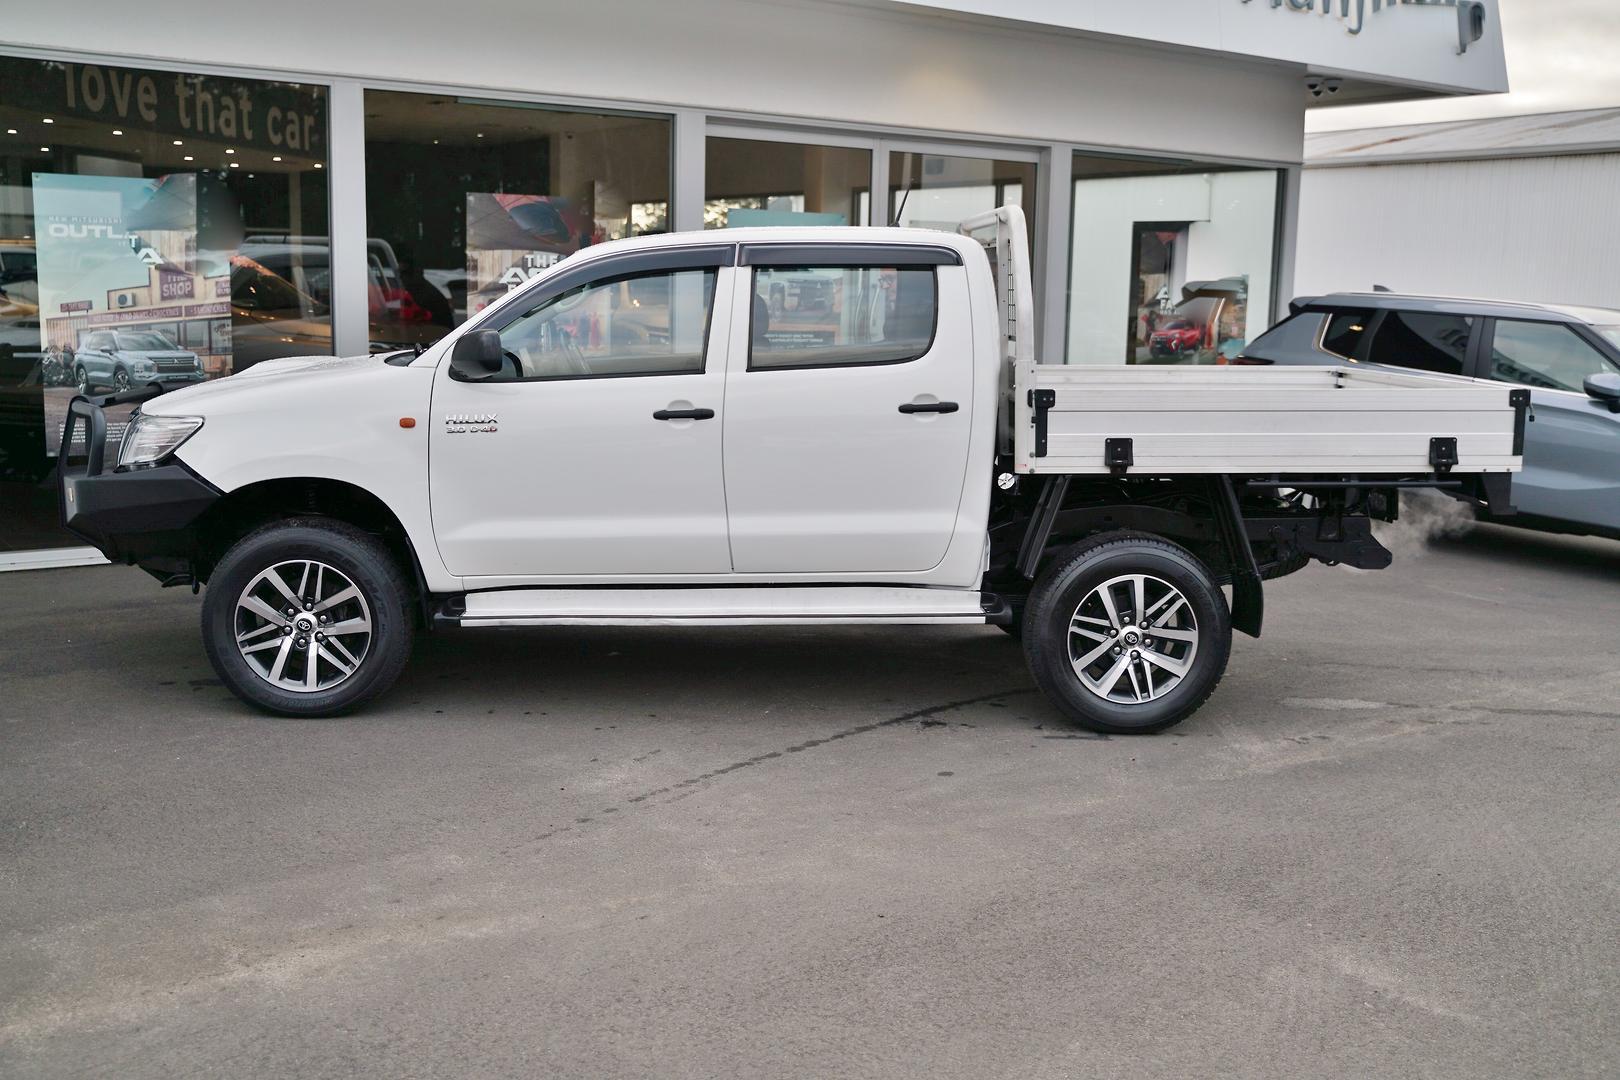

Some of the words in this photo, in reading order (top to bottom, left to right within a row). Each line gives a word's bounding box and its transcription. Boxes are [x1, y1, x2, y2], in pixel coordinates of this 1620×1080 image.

[64, 63, 159, 122] love
[174, 73, 254, 140] that
[266, 105, 316, 151] car
[71, 216, 122, 224] MITSUBISHI
[162, 281, 192, 297] SHOP
[445, 413, 498, 424] HILUX
